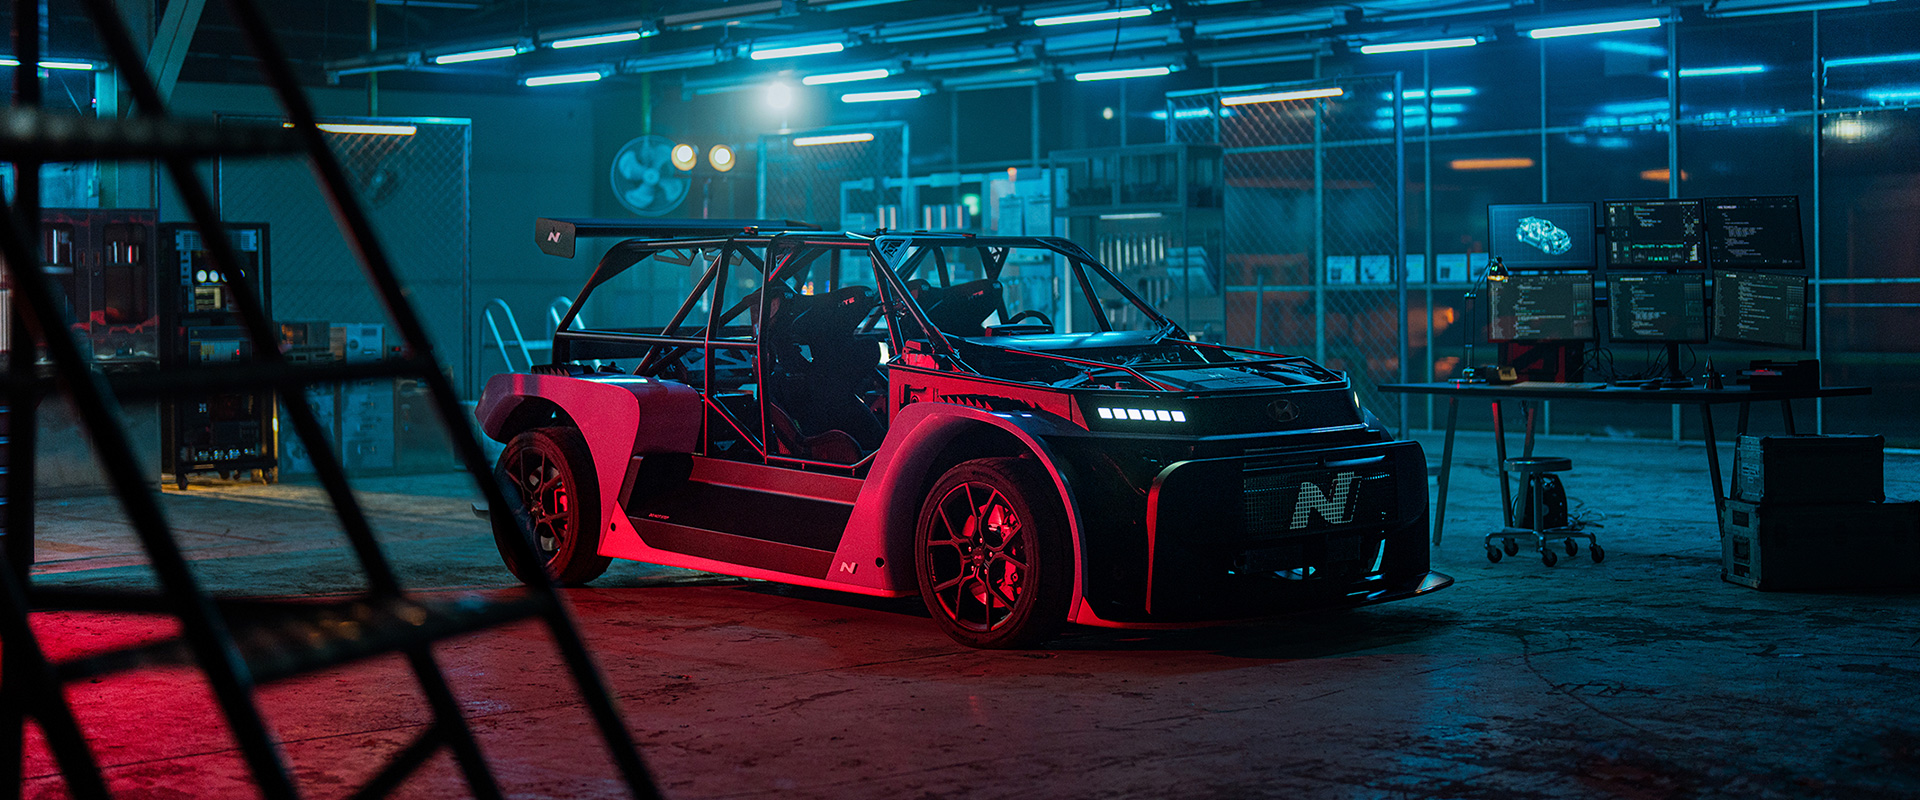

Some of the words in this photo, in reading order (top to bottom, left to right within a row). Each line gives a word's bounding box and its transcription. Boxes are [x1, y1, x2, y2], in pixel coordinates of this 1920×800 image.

[547, 231, 563, 243] N
[1289, 471, 1361, 530] N
[840, 561, 858, 574] N
